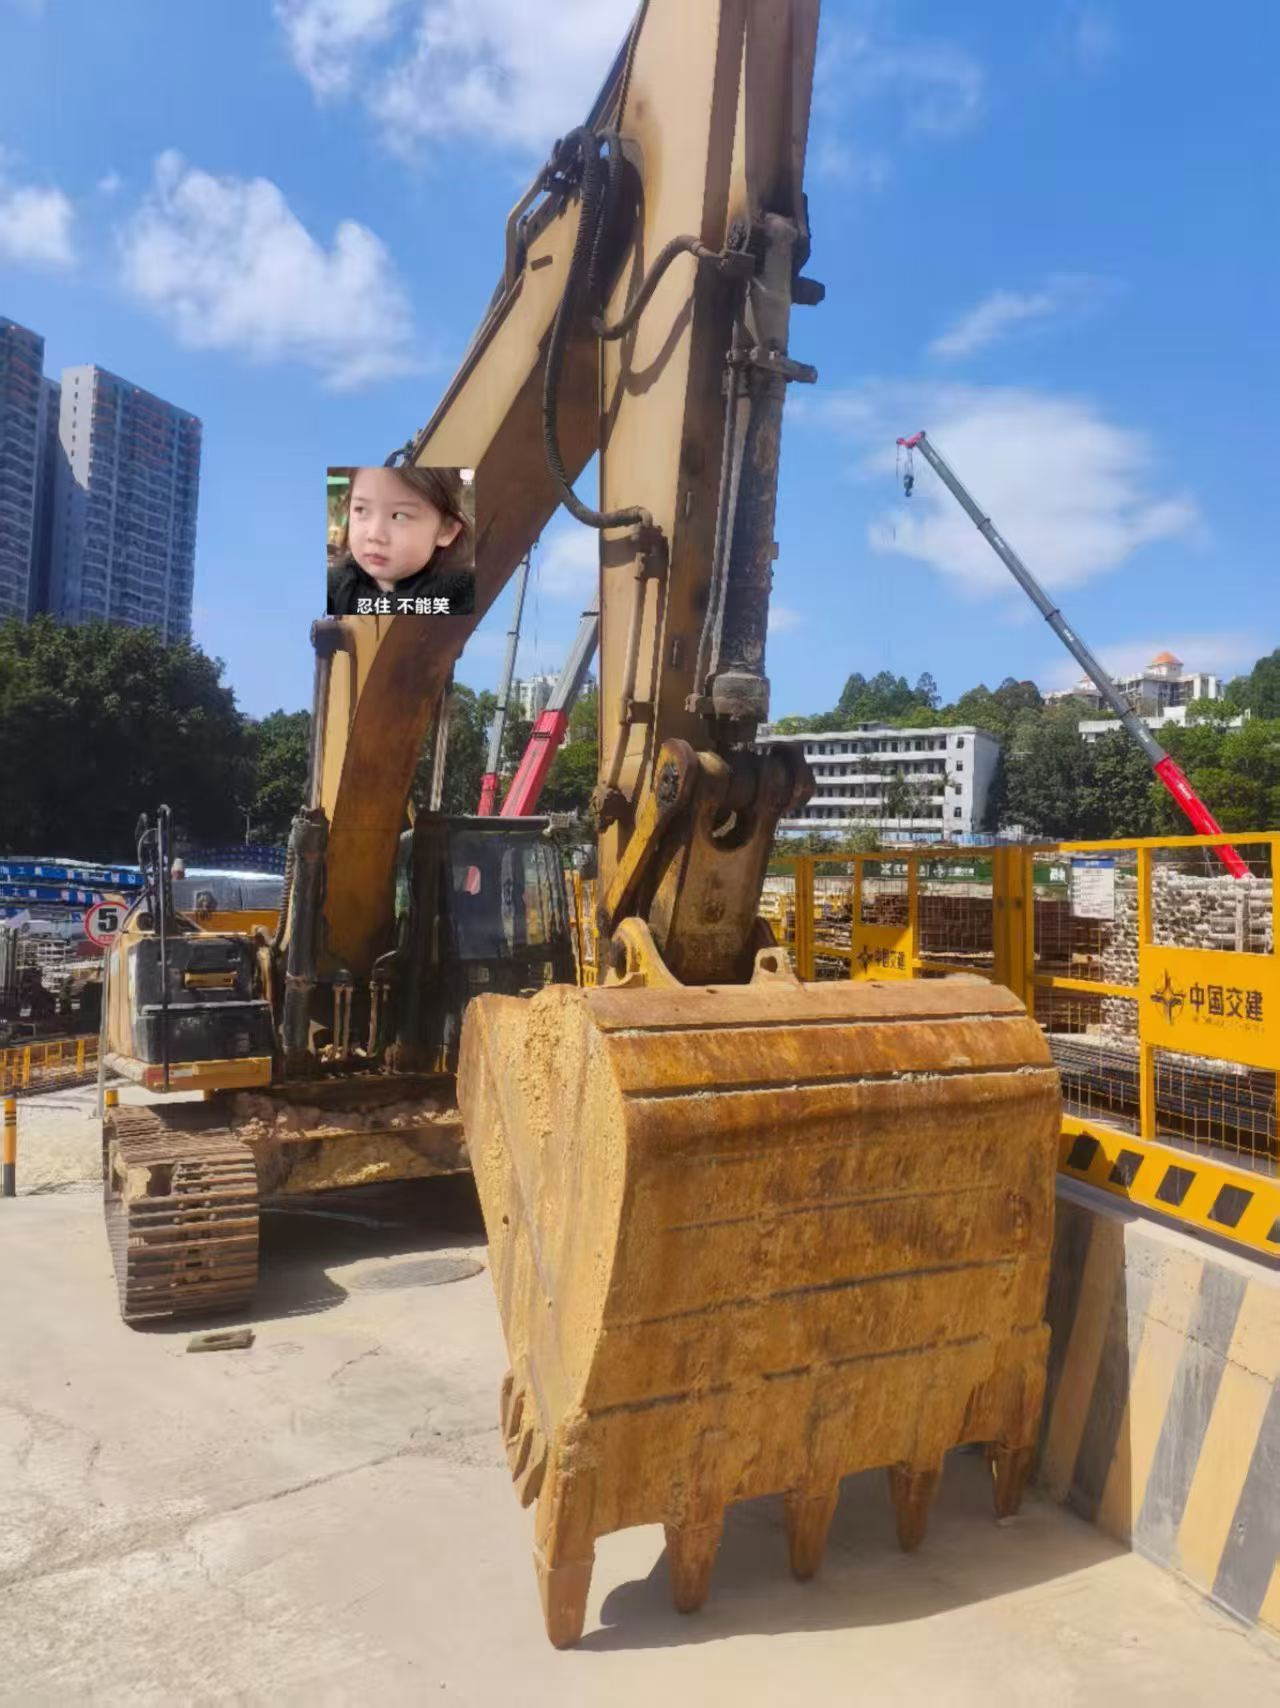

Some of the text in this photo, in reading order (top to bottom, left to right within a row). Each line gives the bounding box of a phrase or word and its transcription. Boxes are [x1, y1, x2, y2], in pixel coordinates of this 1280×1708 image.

[98, 907, 118, 933] 5
[1189, 981, 1264, 1022] 中国交建
